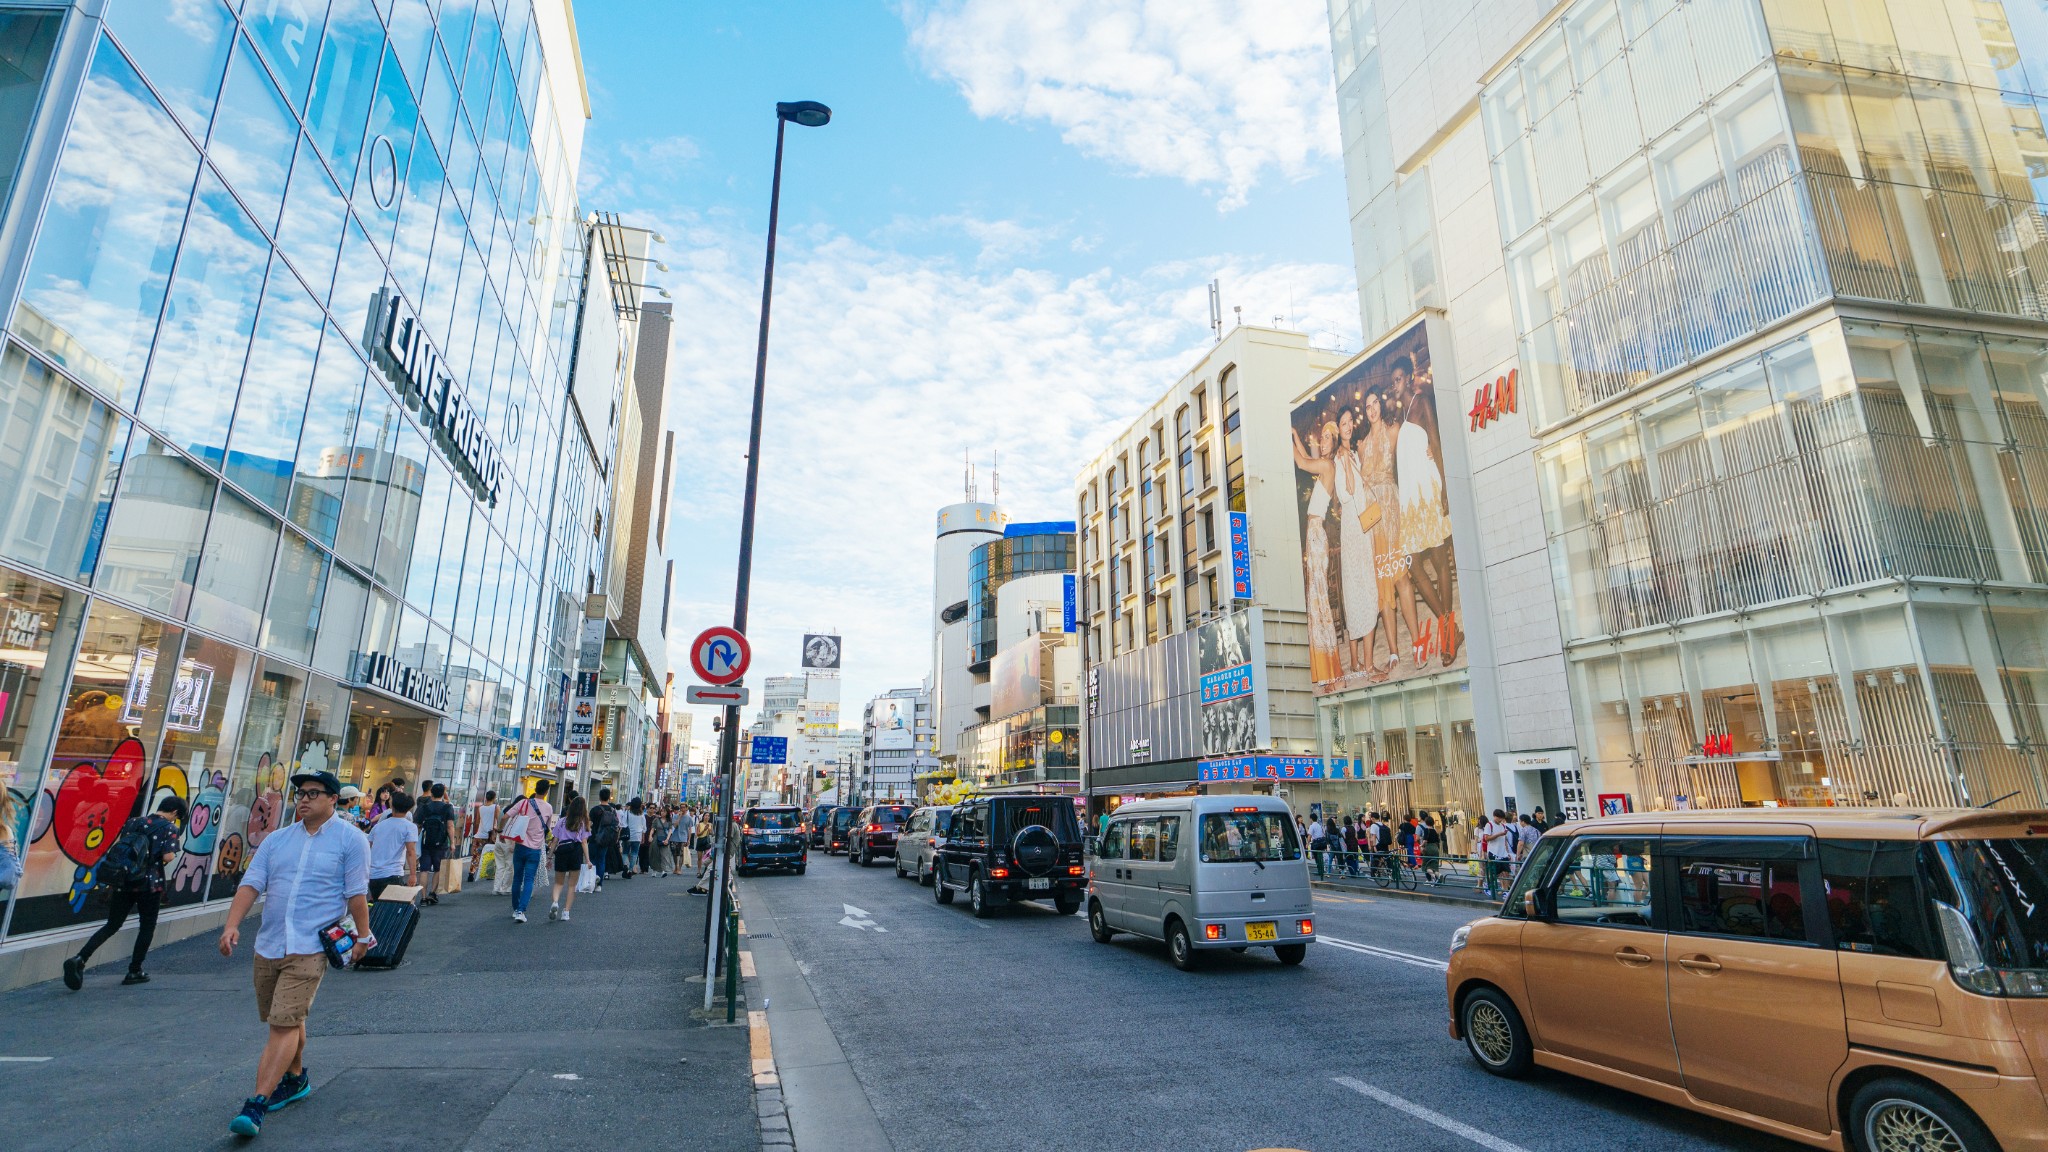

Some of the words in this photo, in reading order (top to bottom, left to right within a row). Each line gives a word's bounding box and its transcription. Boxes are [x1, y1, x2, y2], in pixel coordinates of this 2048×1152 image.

[385, 295, 446, 414] LINE
[440, 378, 504, 503] FRIENDS
[1468, 368, 1518, 432] H&M
[1232, 518, 1246, 592] カラオケ館
[1376, 555, 1412, 579] ¥3,999
[1412, 610, 1455, 663] H&M
[369, 651, 406, 694] LINE
[403, 667, 452, 712] FRIENDS
[1204, 676, 1249, 699] カラオケ館
[1207, 672, 1231, 684] KARAOKE
[529, 753, 546, 761] てんや
[1702, 733, 1733, 758] H&M
[1203, 765, 1250, 779] カラオケ館
